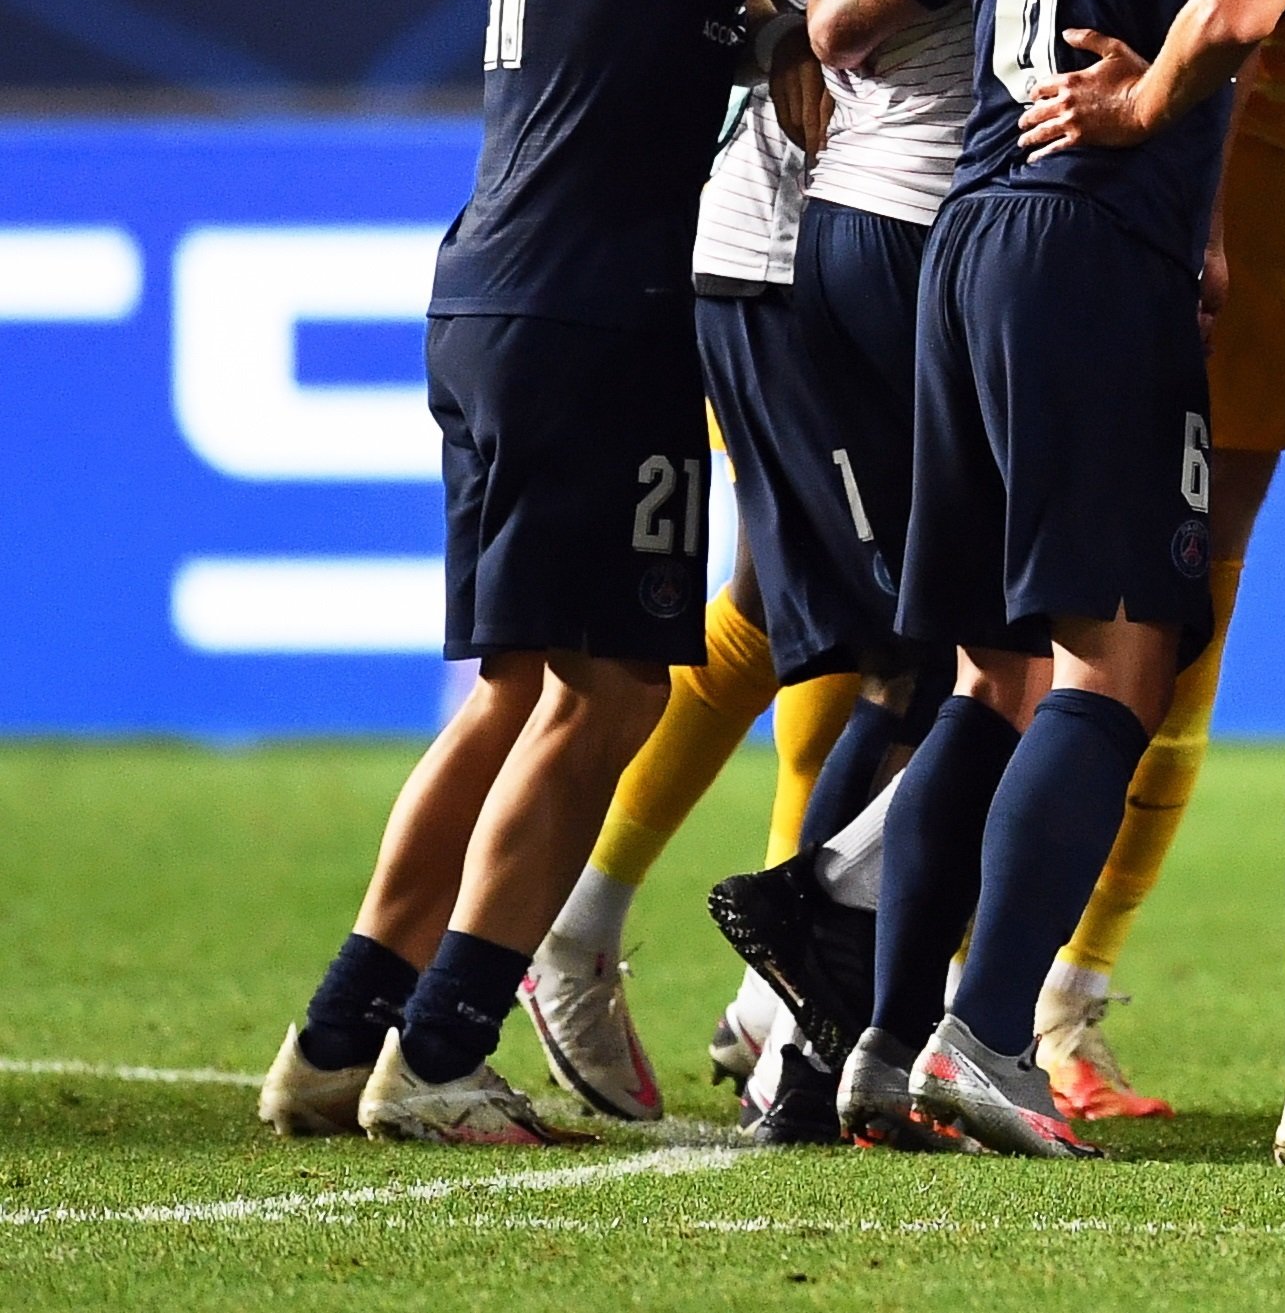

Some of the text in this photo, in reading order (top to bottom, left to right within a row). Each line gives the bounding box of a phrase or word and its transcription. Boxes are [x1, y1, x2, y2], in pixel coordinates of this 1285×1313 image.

[631, 454, 700, 557] 21
[832, 448, 874, 543] 1
[1180, 410, 1210, 514] 6
